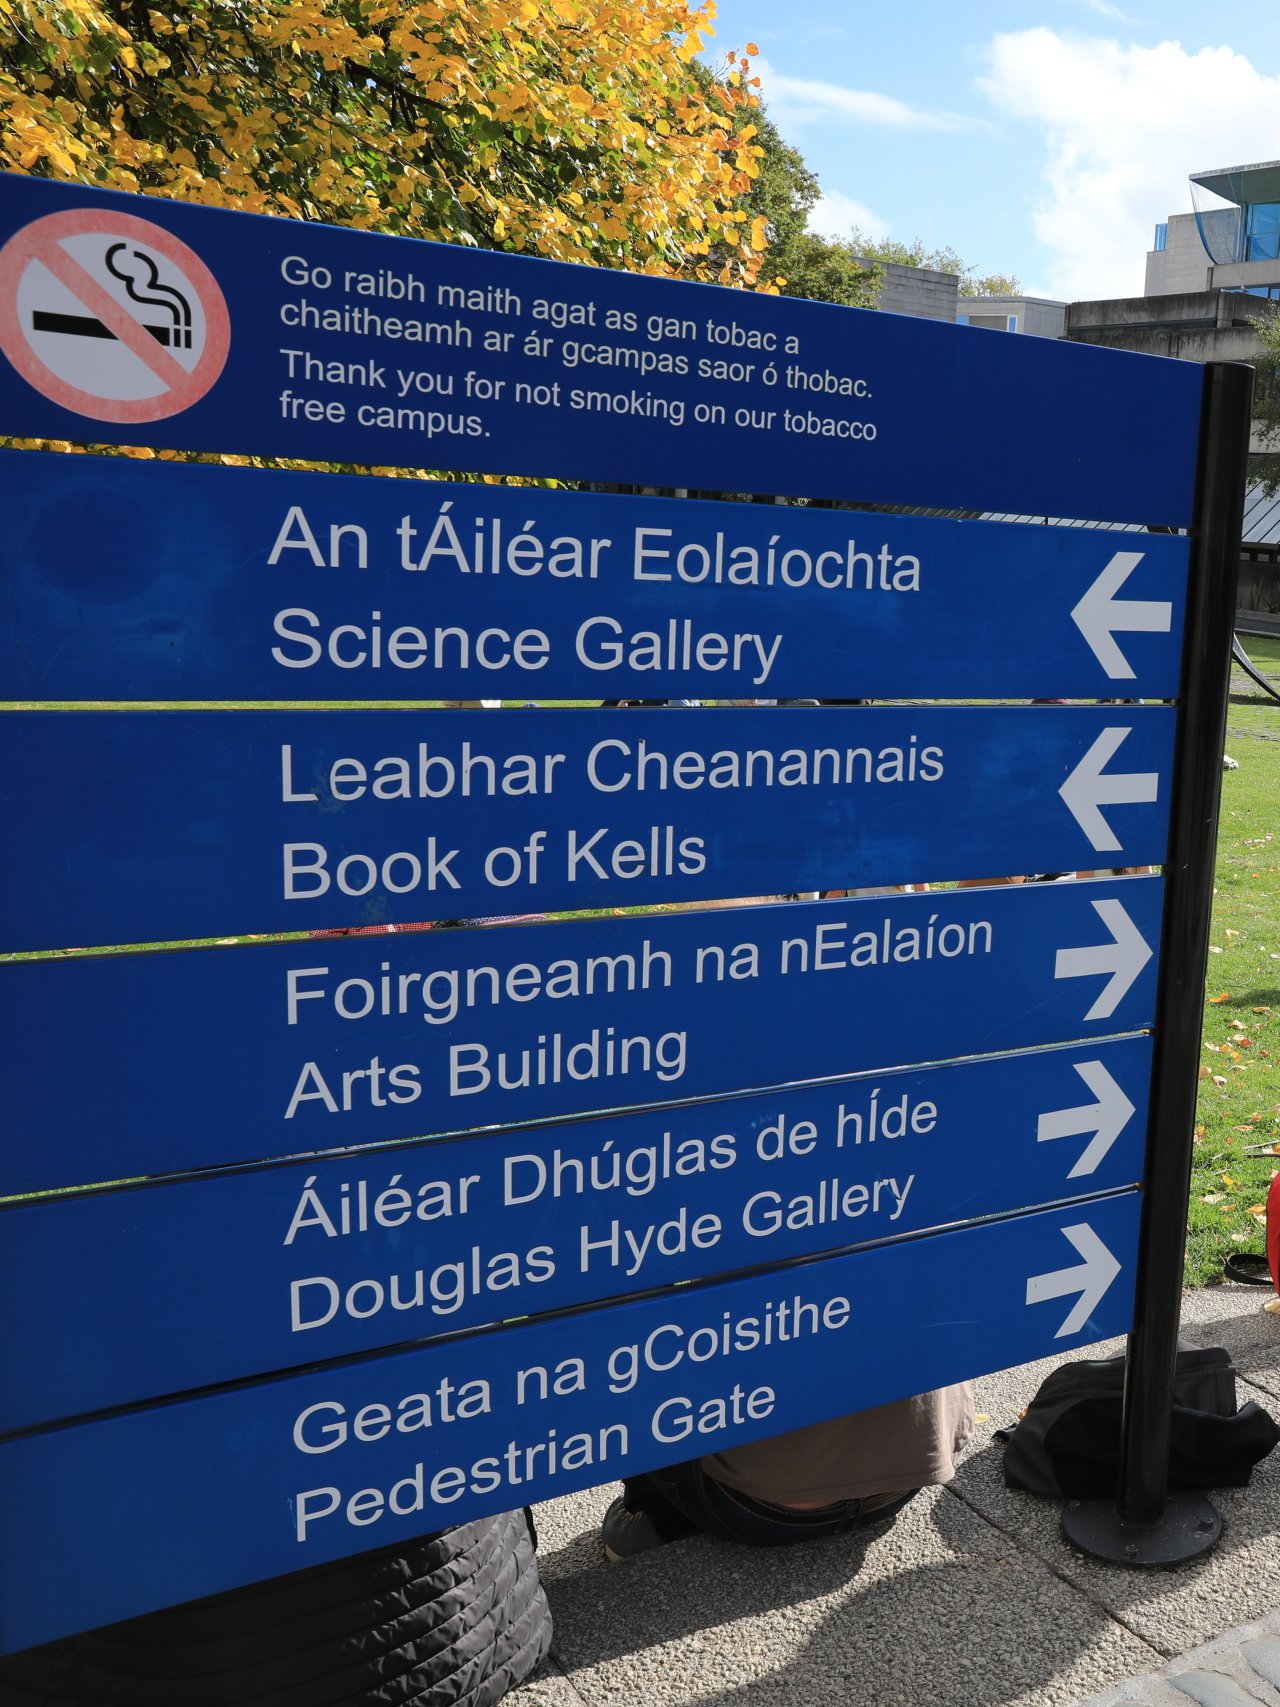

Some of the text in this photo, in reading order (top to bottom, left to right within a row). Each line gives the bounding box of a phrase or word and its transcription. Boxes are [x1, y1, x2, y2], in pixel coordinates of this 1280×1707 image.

[280, 298, 872, 398] chaitheamh ar ár gcampas saor ó thobac.
[281, 255, 799, 355] Go raibh maith agat as gan tobac a
[279, 348, 877, 441] Thank you for not smoking on our tobacco
[279, 389, 490, 439] free campus.
[267, 501, 920, 592] An tÁiléar Eolaíochta
[271, 607, 783, 685] Science Gallery
[281, 735, 944, 802] Leabhar Cheanannais
[283, 826, 706, 900] Book of Kells
[287, 914, 993, 1025] Foirgneamh na nEalaíon
[284, 1027, 687, 1119] Arts Building
[283, 1087, 938, 1246] Áiléar Dhúglas de hÍde
[290, 1174, 915, 1333] Douglas Hyde Gallery
[293, 1295, 851, 1454] Geata na gCoisithe
[296, 1383, 776, 1543] Pedestrian Gate
